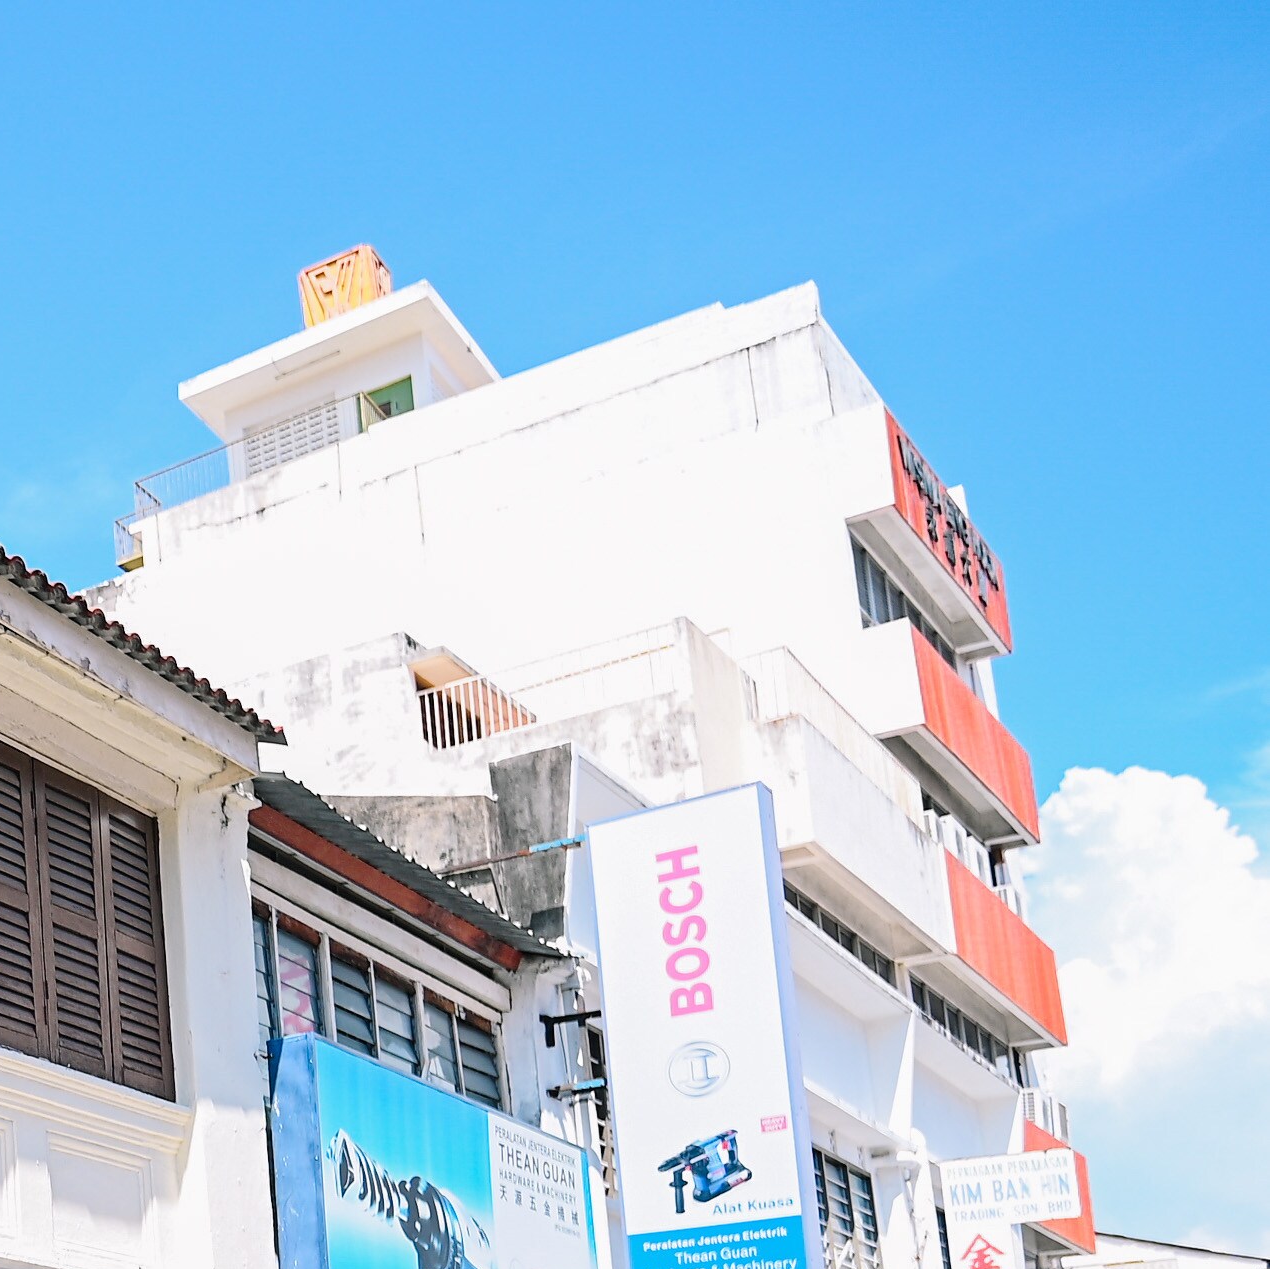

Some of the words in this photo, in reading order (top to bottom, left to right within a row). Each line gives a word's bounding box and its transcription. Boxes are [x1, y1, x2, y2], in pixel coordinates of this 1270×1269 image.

[655, 845, 714, 1017] BOSCH
[495, 1125, 526, 1147] PERALATAN
[499, 1143, 539, 1175] THEAN
[543, 1161, 575, 1189] GUAN
[500, 1169, 534, 1192] HARDWARE
[542, 1185, 576, 1205] MACHINERY
[949, 1182, 983, 1206] KIM
[992, 1177, 1031, 1202] BAN
[713, 1203, 743, 1216] Alat
[747, 1197, 794, 1212] Kuasa
[954, 1207, 1005, 1223] TRADING
[1048, 1200, 1072, 1213] BHD
[643, 1236, 695, 1252] Peralatan
[697, 1232, 741, 1248] Jentera
[743, 1226, 787, 1242] Elektrik
[675, 1250, 717, 1265] Thean
[720, 1246, 757, 1260] Guan
